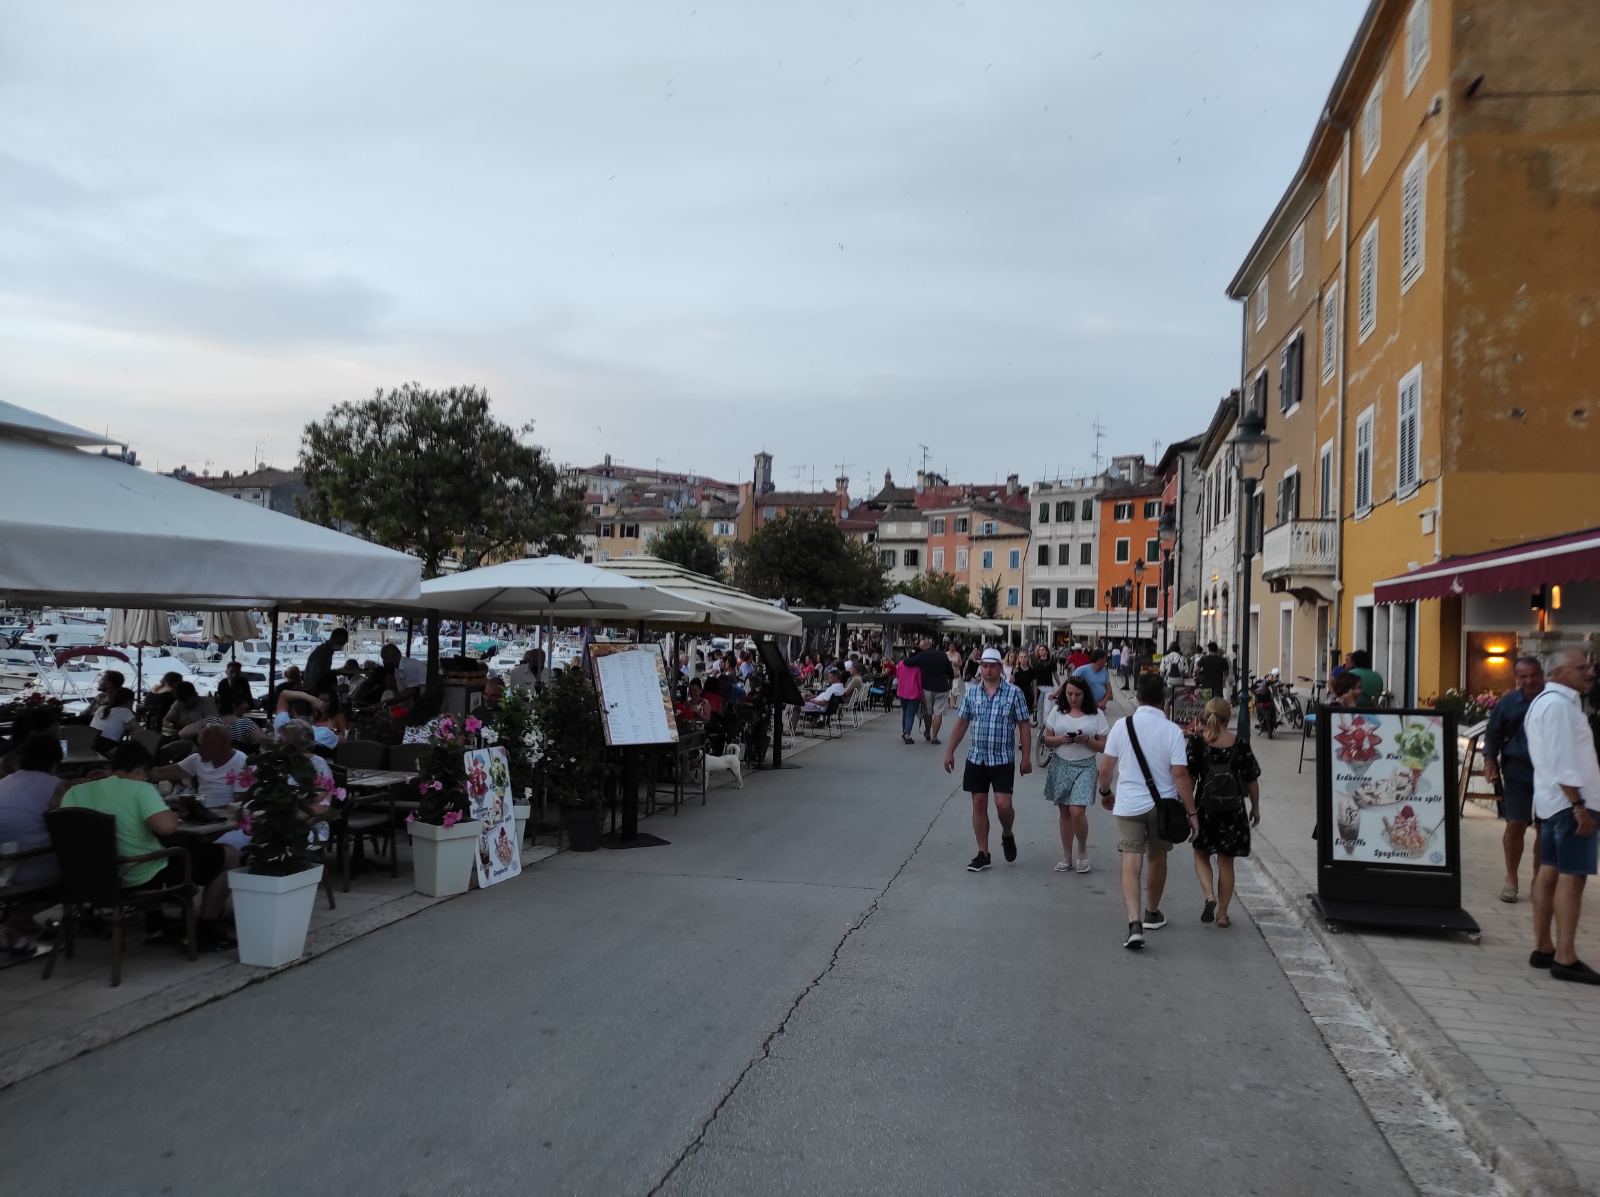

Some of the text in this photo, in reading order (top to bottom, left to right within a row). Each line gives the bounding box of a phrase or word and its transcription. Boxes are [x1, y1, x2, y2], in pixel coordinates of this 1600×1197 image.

[1386, 752, 1403, 760] Kiwi
[1336, 774, 1372, 782] Erdbeeren
[1395, 794, 1442, 804] Banana split
[1374, 849, 1409, 859] Spaghetti
